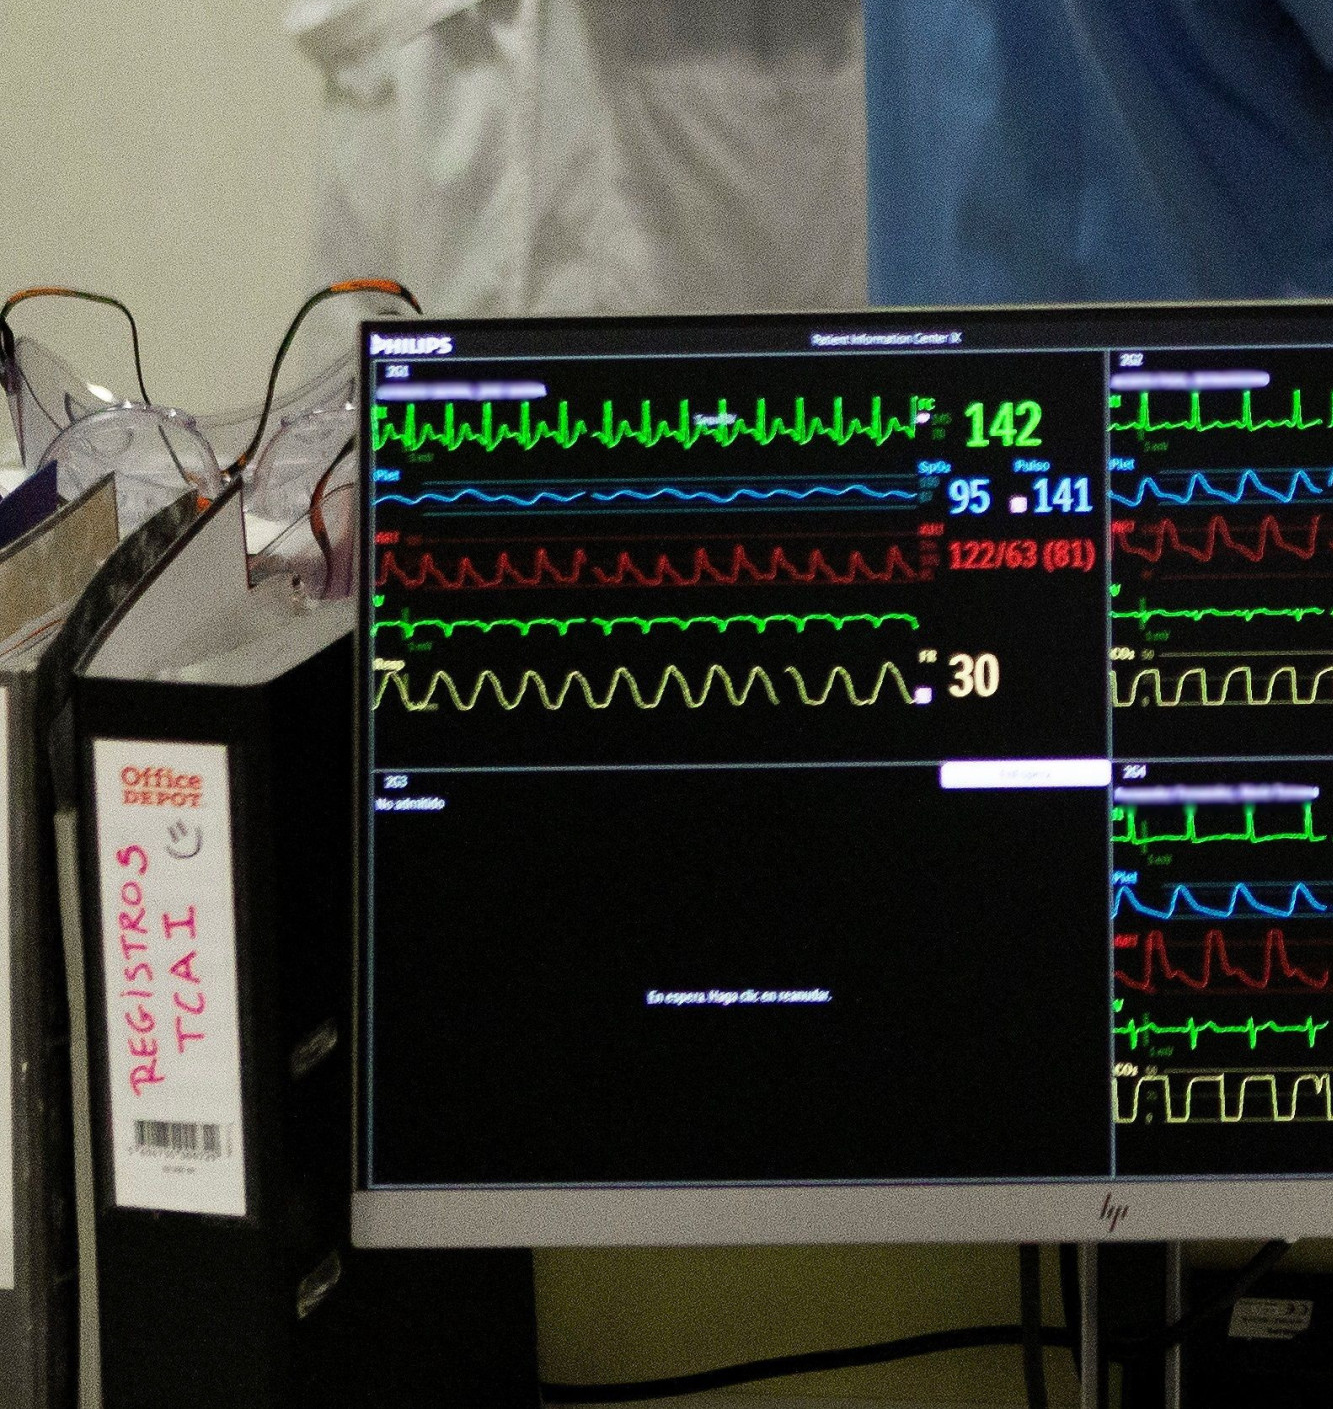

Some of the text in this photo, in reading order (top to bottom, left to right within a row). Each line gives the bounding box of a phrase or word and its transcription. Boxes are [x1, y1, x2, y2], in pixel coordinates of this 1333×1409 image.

[370, 334, 453, 355] PHILIPS
[965, 400, 1042, 447] 142
[949, 478, 991, 514] 95
[1033, 477, 1093, 514] 141
[949, 540, 1038, 570] 122/63
[1043, 539, 1096, 572] (81)
[949, 653, 1000, 697] 30
[120, 765, 202, 791] Office
[123, 790, 203, 809] DEPOT
[116, 844, 164, 1096] REGISTROS
